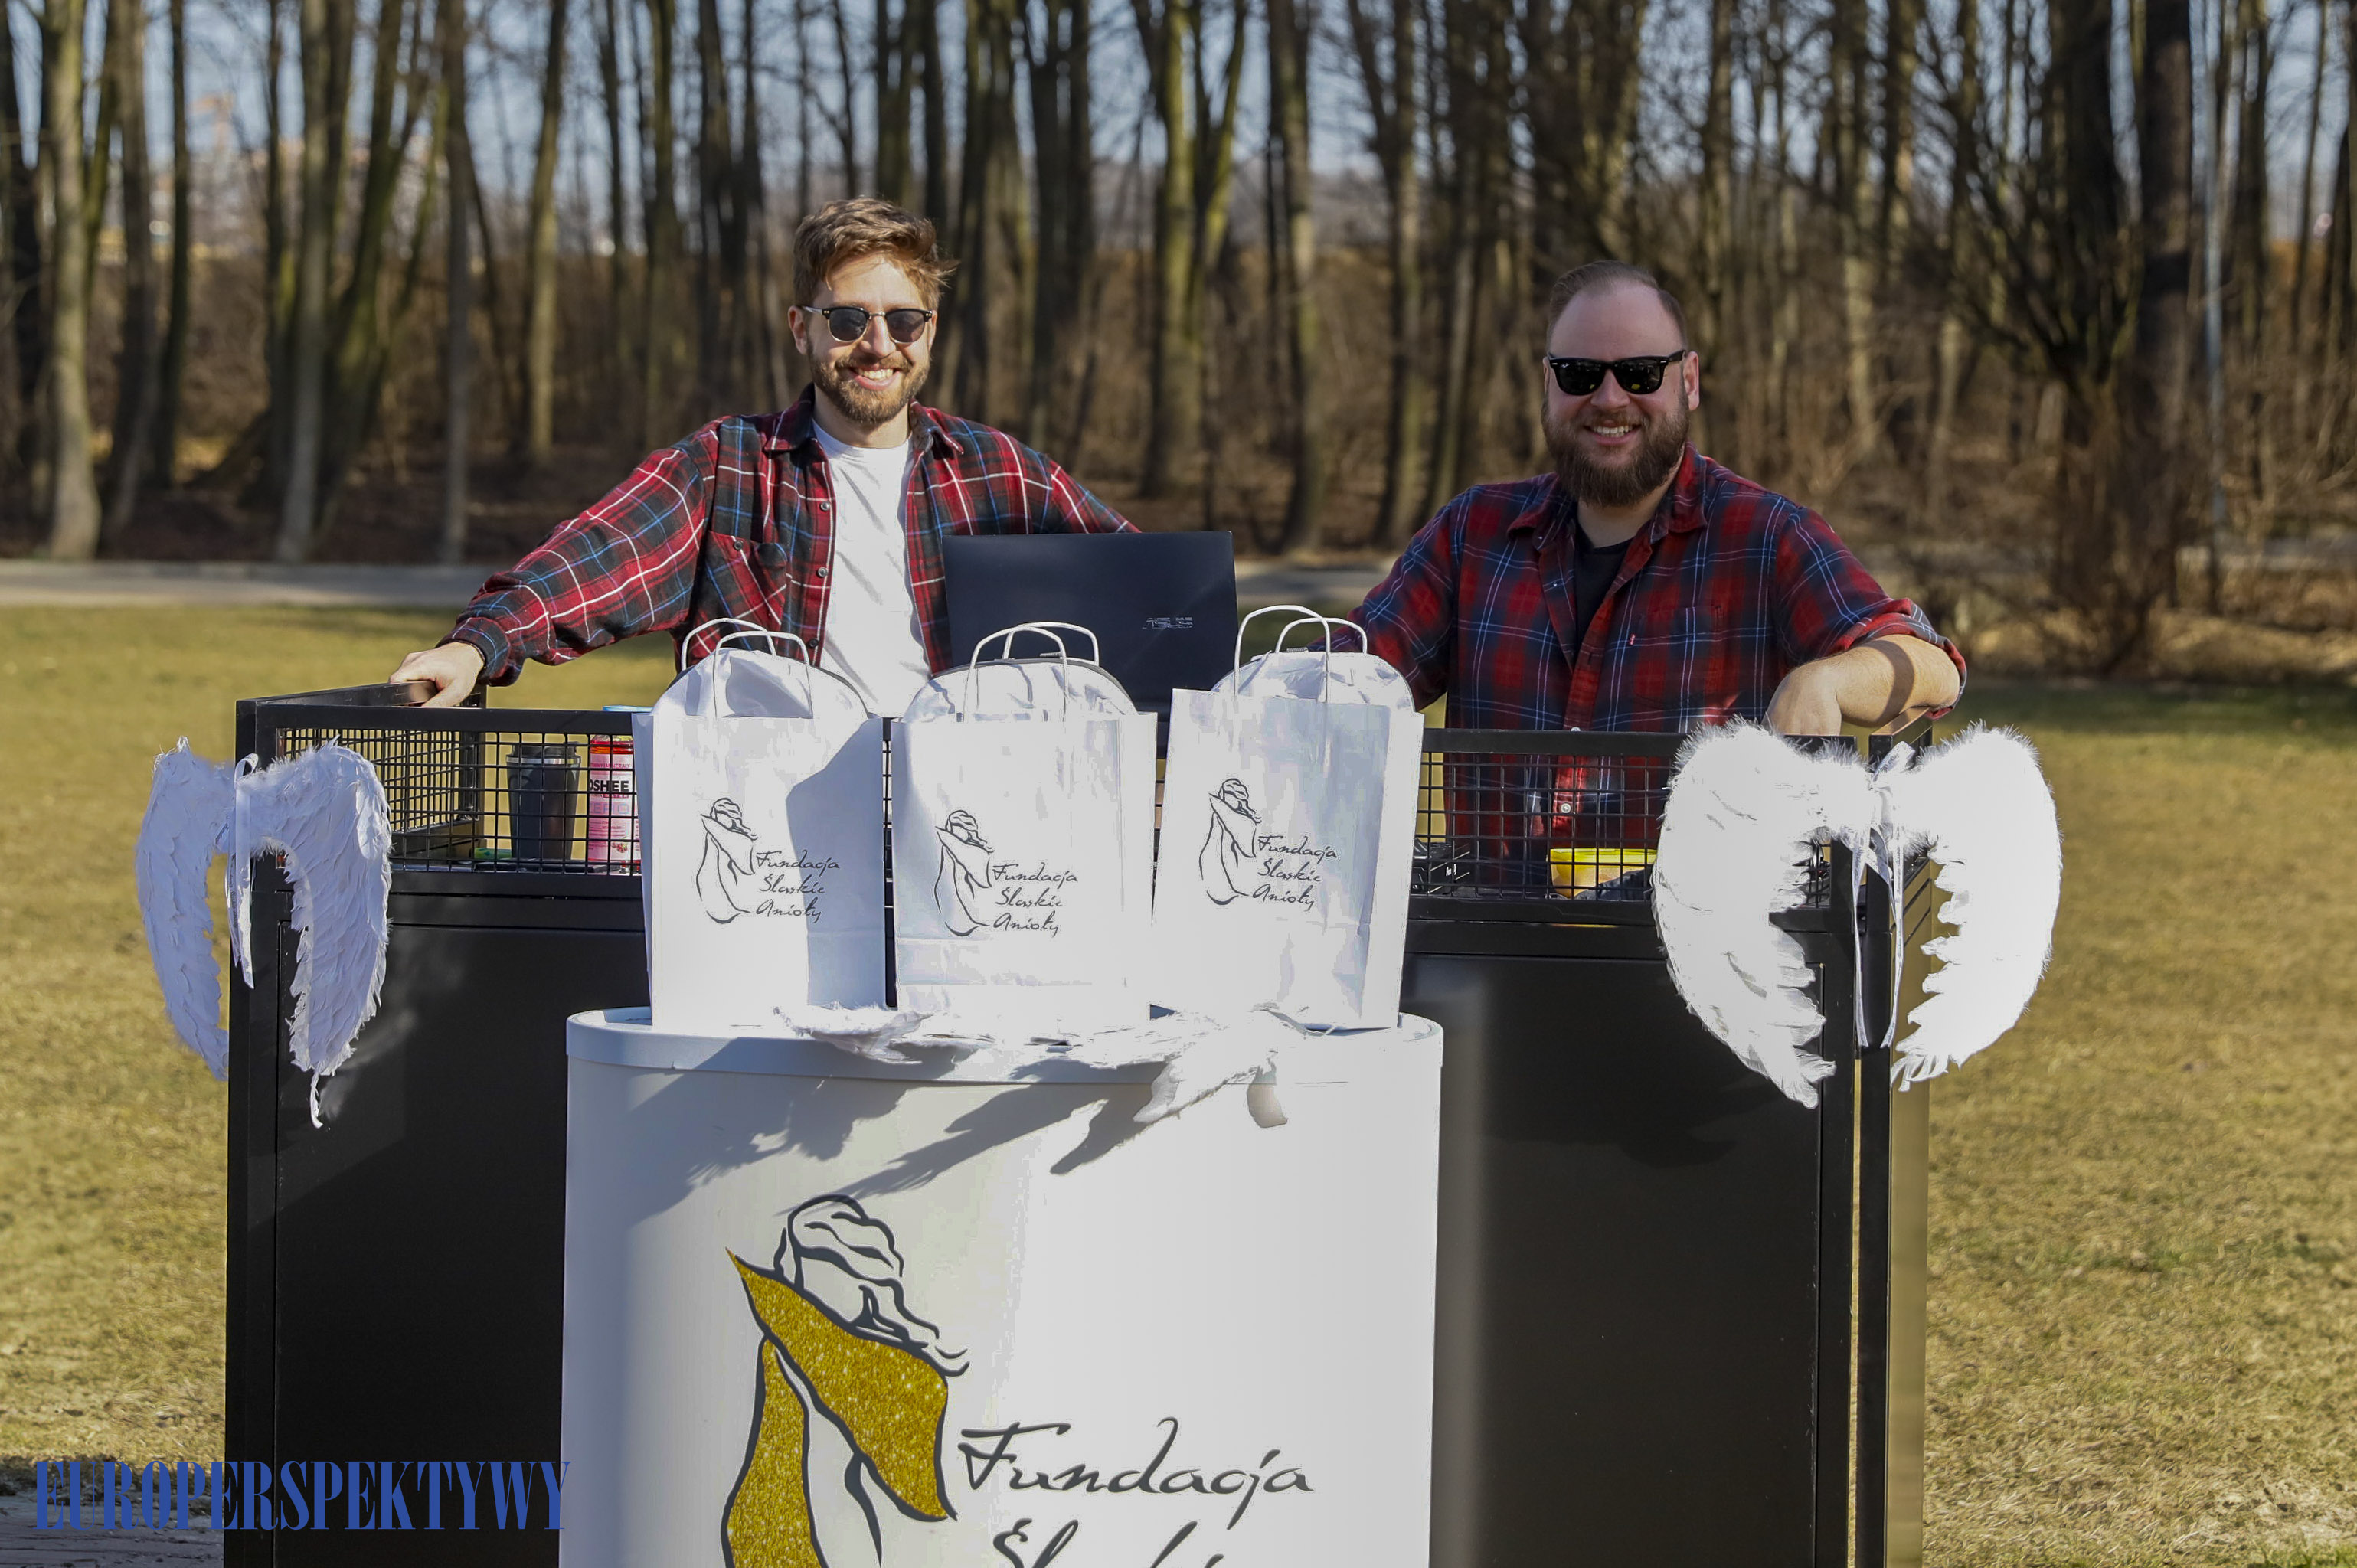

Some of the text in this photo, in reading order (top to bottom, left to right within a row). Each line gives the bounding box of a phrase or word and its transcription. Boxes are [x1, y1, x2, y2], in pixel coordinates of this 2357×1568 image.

[756, 849, 840, 877] Fundacja
[1258, 835, 1337, 864] Fundacja
[992, 862, 1077, 889] Fundacja
[756, 897, 821, 923] Anioły
[1253, 884, 1314, 911] Anioły
[993, 910, 1059, 938] Anioły
[958, 1416, 1314, 1530] Fundacja
